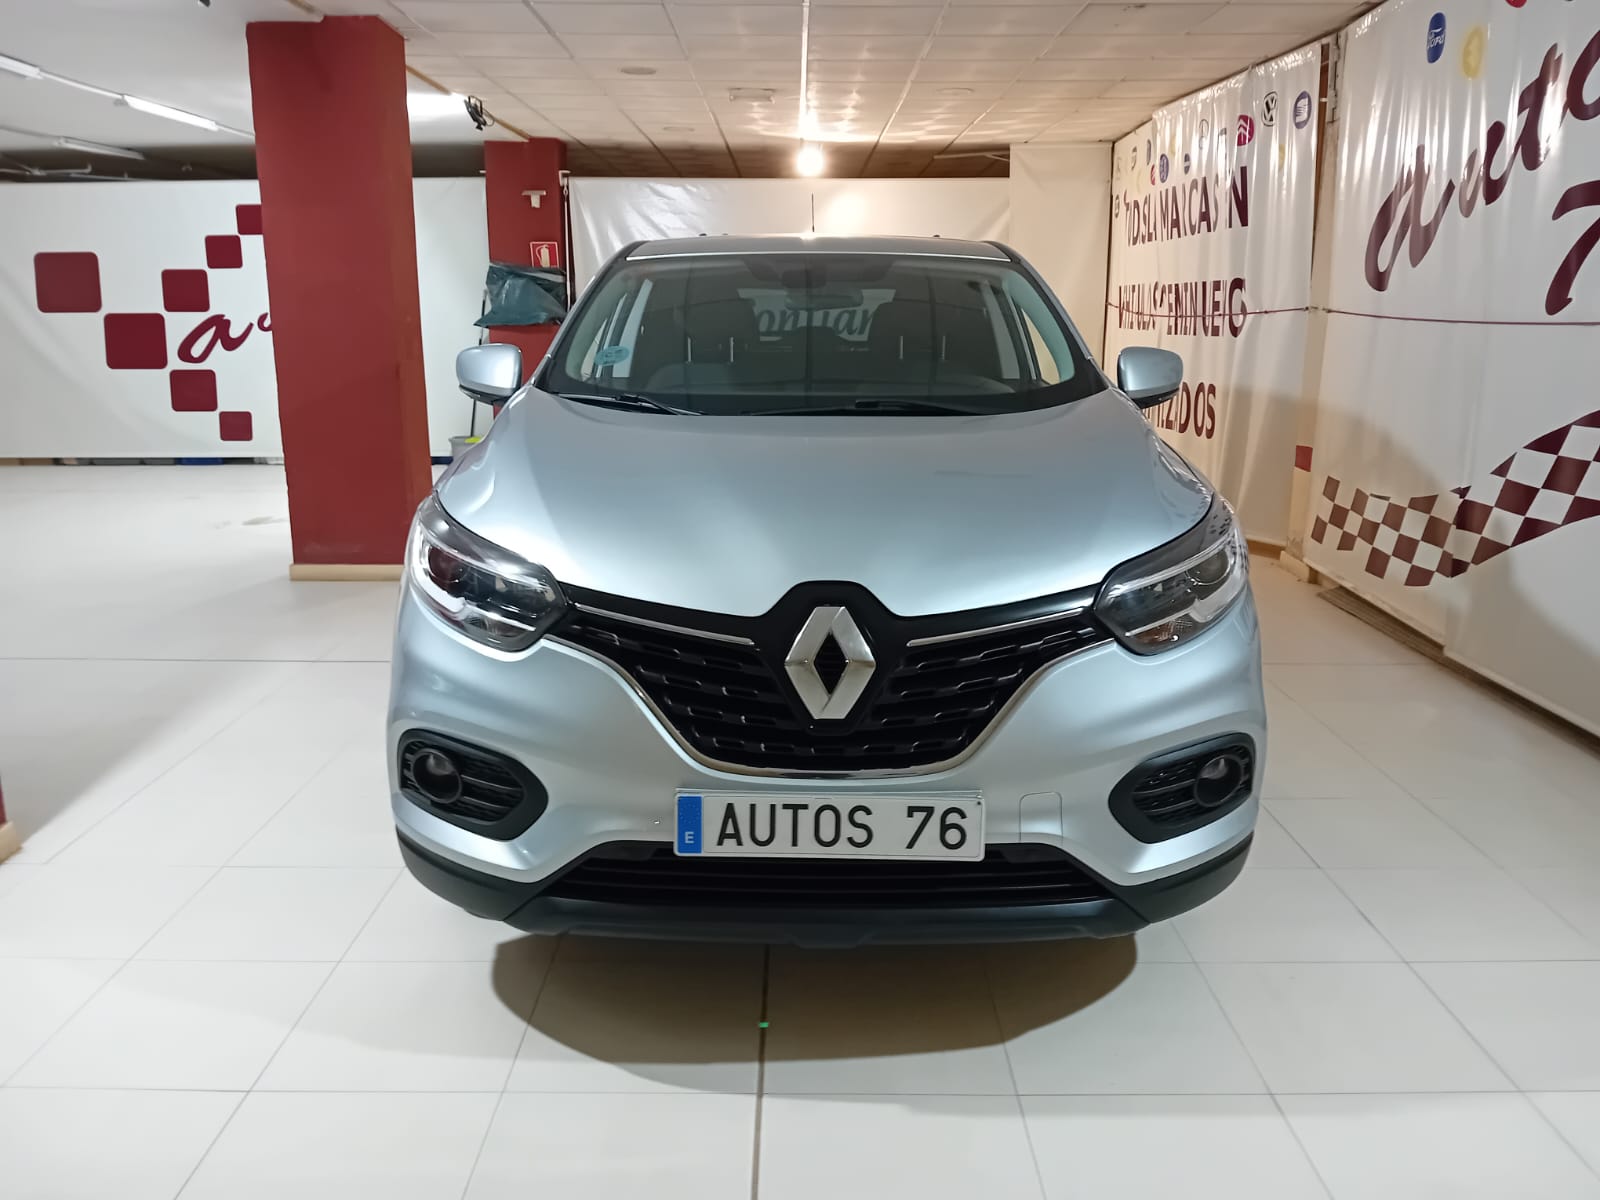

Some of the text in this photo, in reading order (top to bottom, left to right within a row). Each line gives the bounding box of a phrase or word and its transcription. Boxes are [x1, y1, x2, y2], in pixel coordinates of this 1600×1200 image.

[684, 831, 695, 844] E
[716, 802, 968, 851] AUTOS 76
